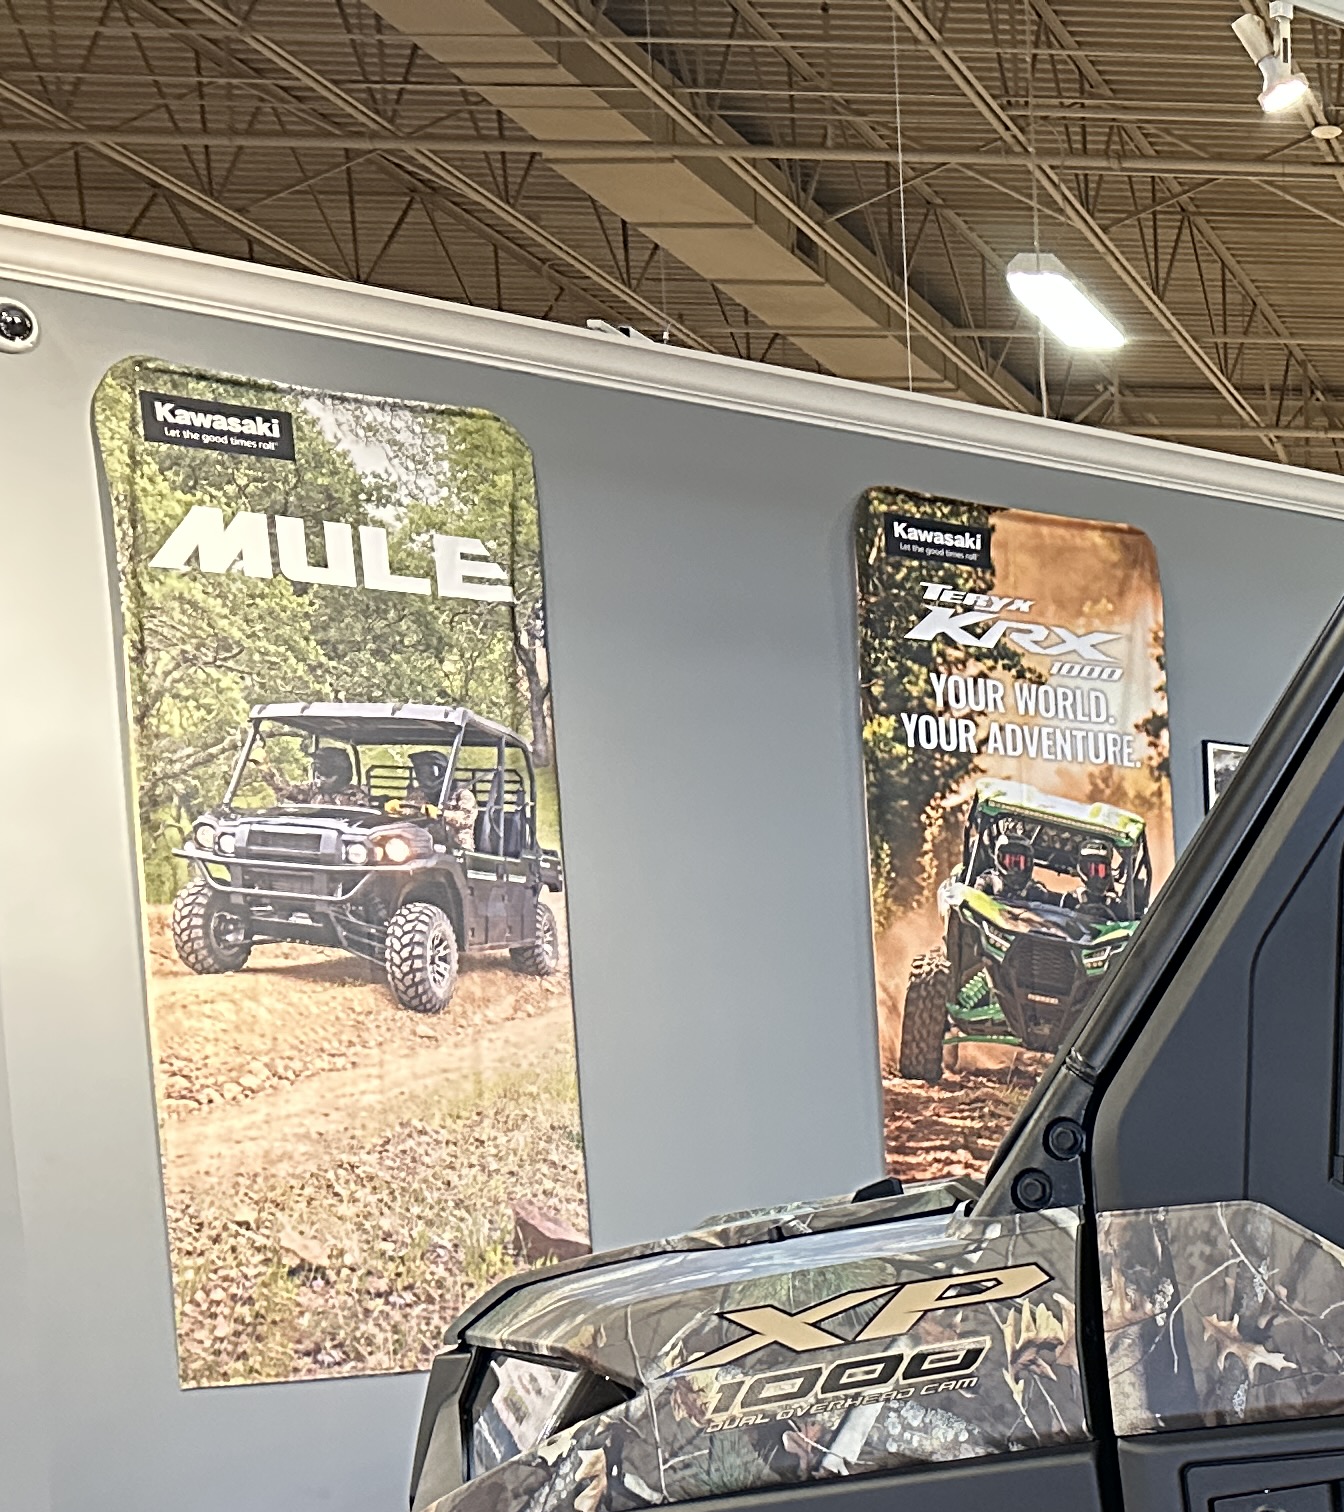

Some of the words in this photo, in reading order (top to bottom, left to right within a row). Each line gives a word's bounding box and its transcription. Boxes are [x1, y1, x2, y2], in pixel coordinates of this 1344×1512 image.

[154, 401, 281, 438] Kawasaki
[164, 427, 181, 438] Let
[183, 429, 200, 440] the
[202, 433, 229, 445] good
[230, 436, 257, 449] times
[148, 505, 517, 602] MULE
[893, 521, 982, 550] Kawasaki
[920, 582, 1035, 612] TERYX
[904, 604, 1126, 662] KRX
[930, 673, 1005, 713] YOUR
[1014, 682, 1116, 723] WORLD.
[1050, 662, 1124, 681] 1000
[901, 712, 978, 754] YOUR
[987, 721, 1142, 768] ADVENTURE.
[656, 1262, 1054, 1380] XP
[707, 1336, 992, 1416] 1000
[706, 1414, 770, 1433] DUAL
[777, 1388, 913, 1421] OVERHEAD
[919, 1376, 979, 1396] CAM
